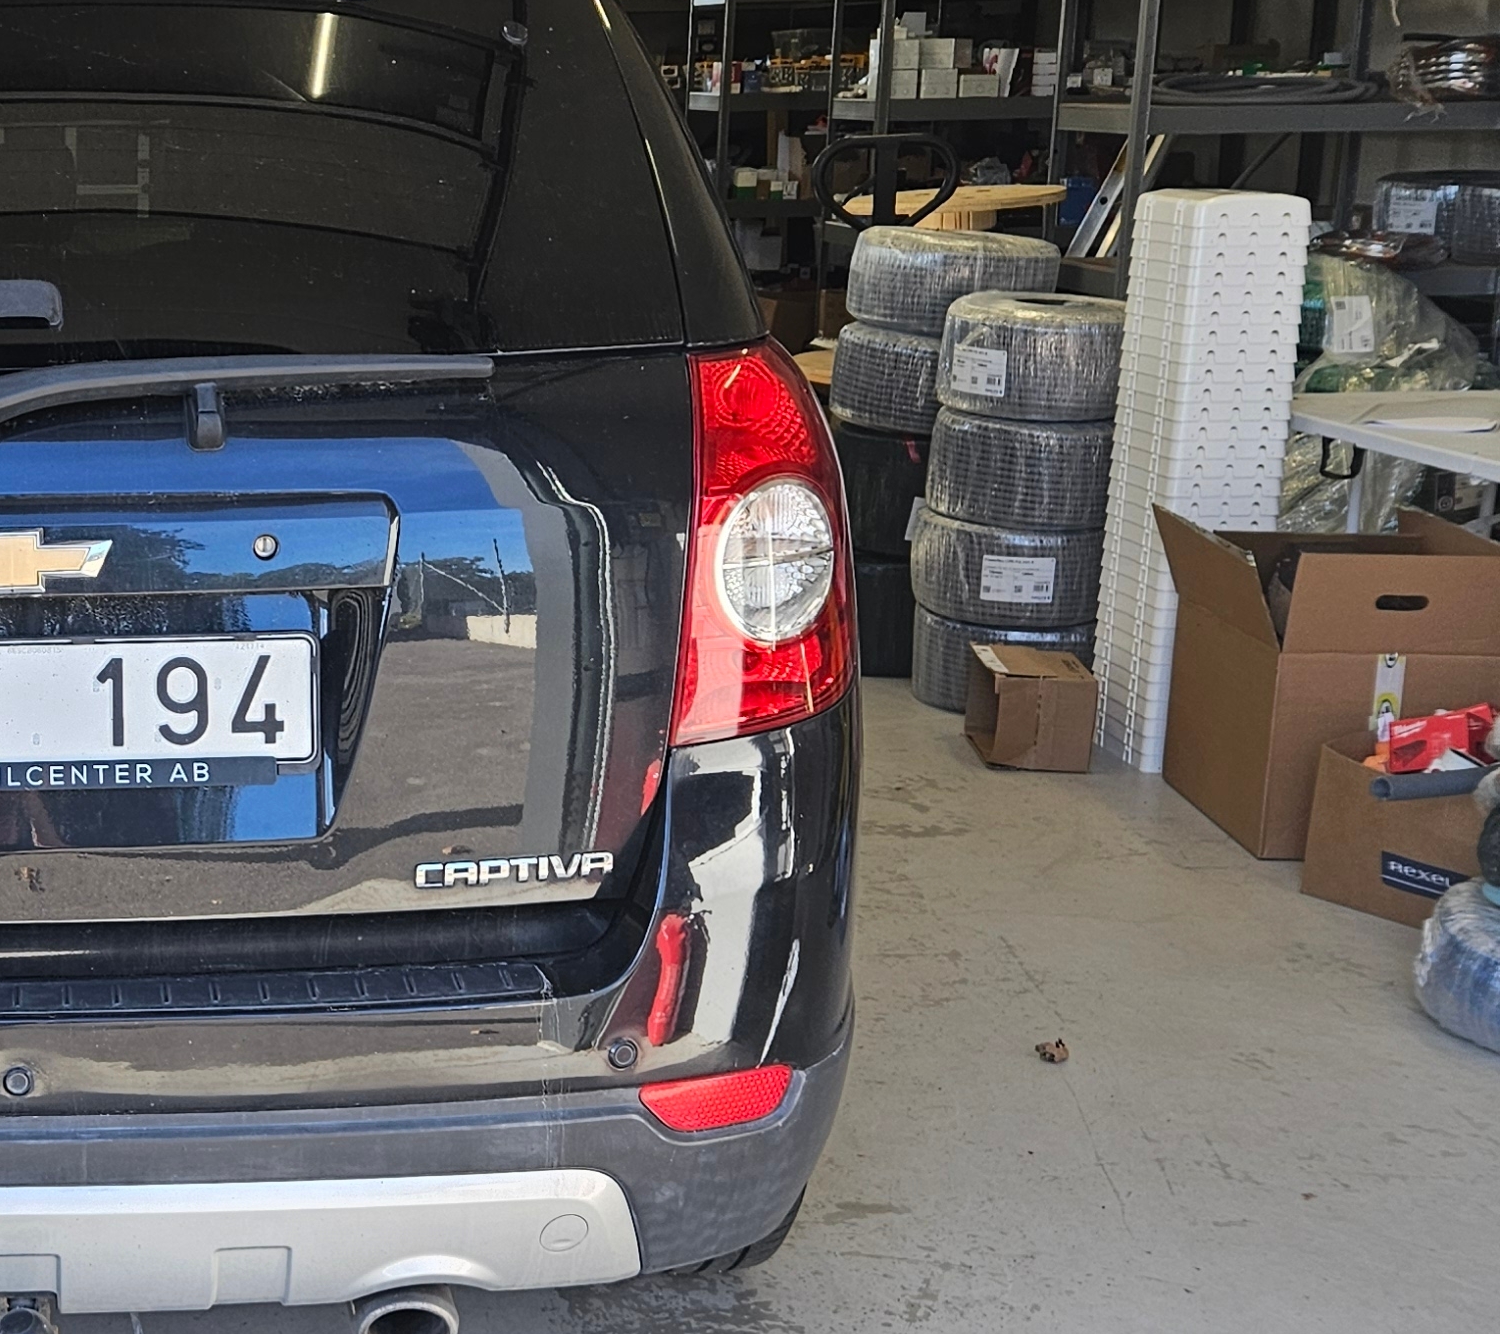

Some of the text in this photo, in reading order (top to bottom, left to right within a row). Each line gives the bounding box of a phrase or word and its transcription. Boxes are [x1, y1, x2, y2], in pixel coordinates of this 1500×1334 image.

[95, 654, 285, 747] 194
[169, 763, 210, 784] AB
[415, 851, 614, 888] CAPTIVA
